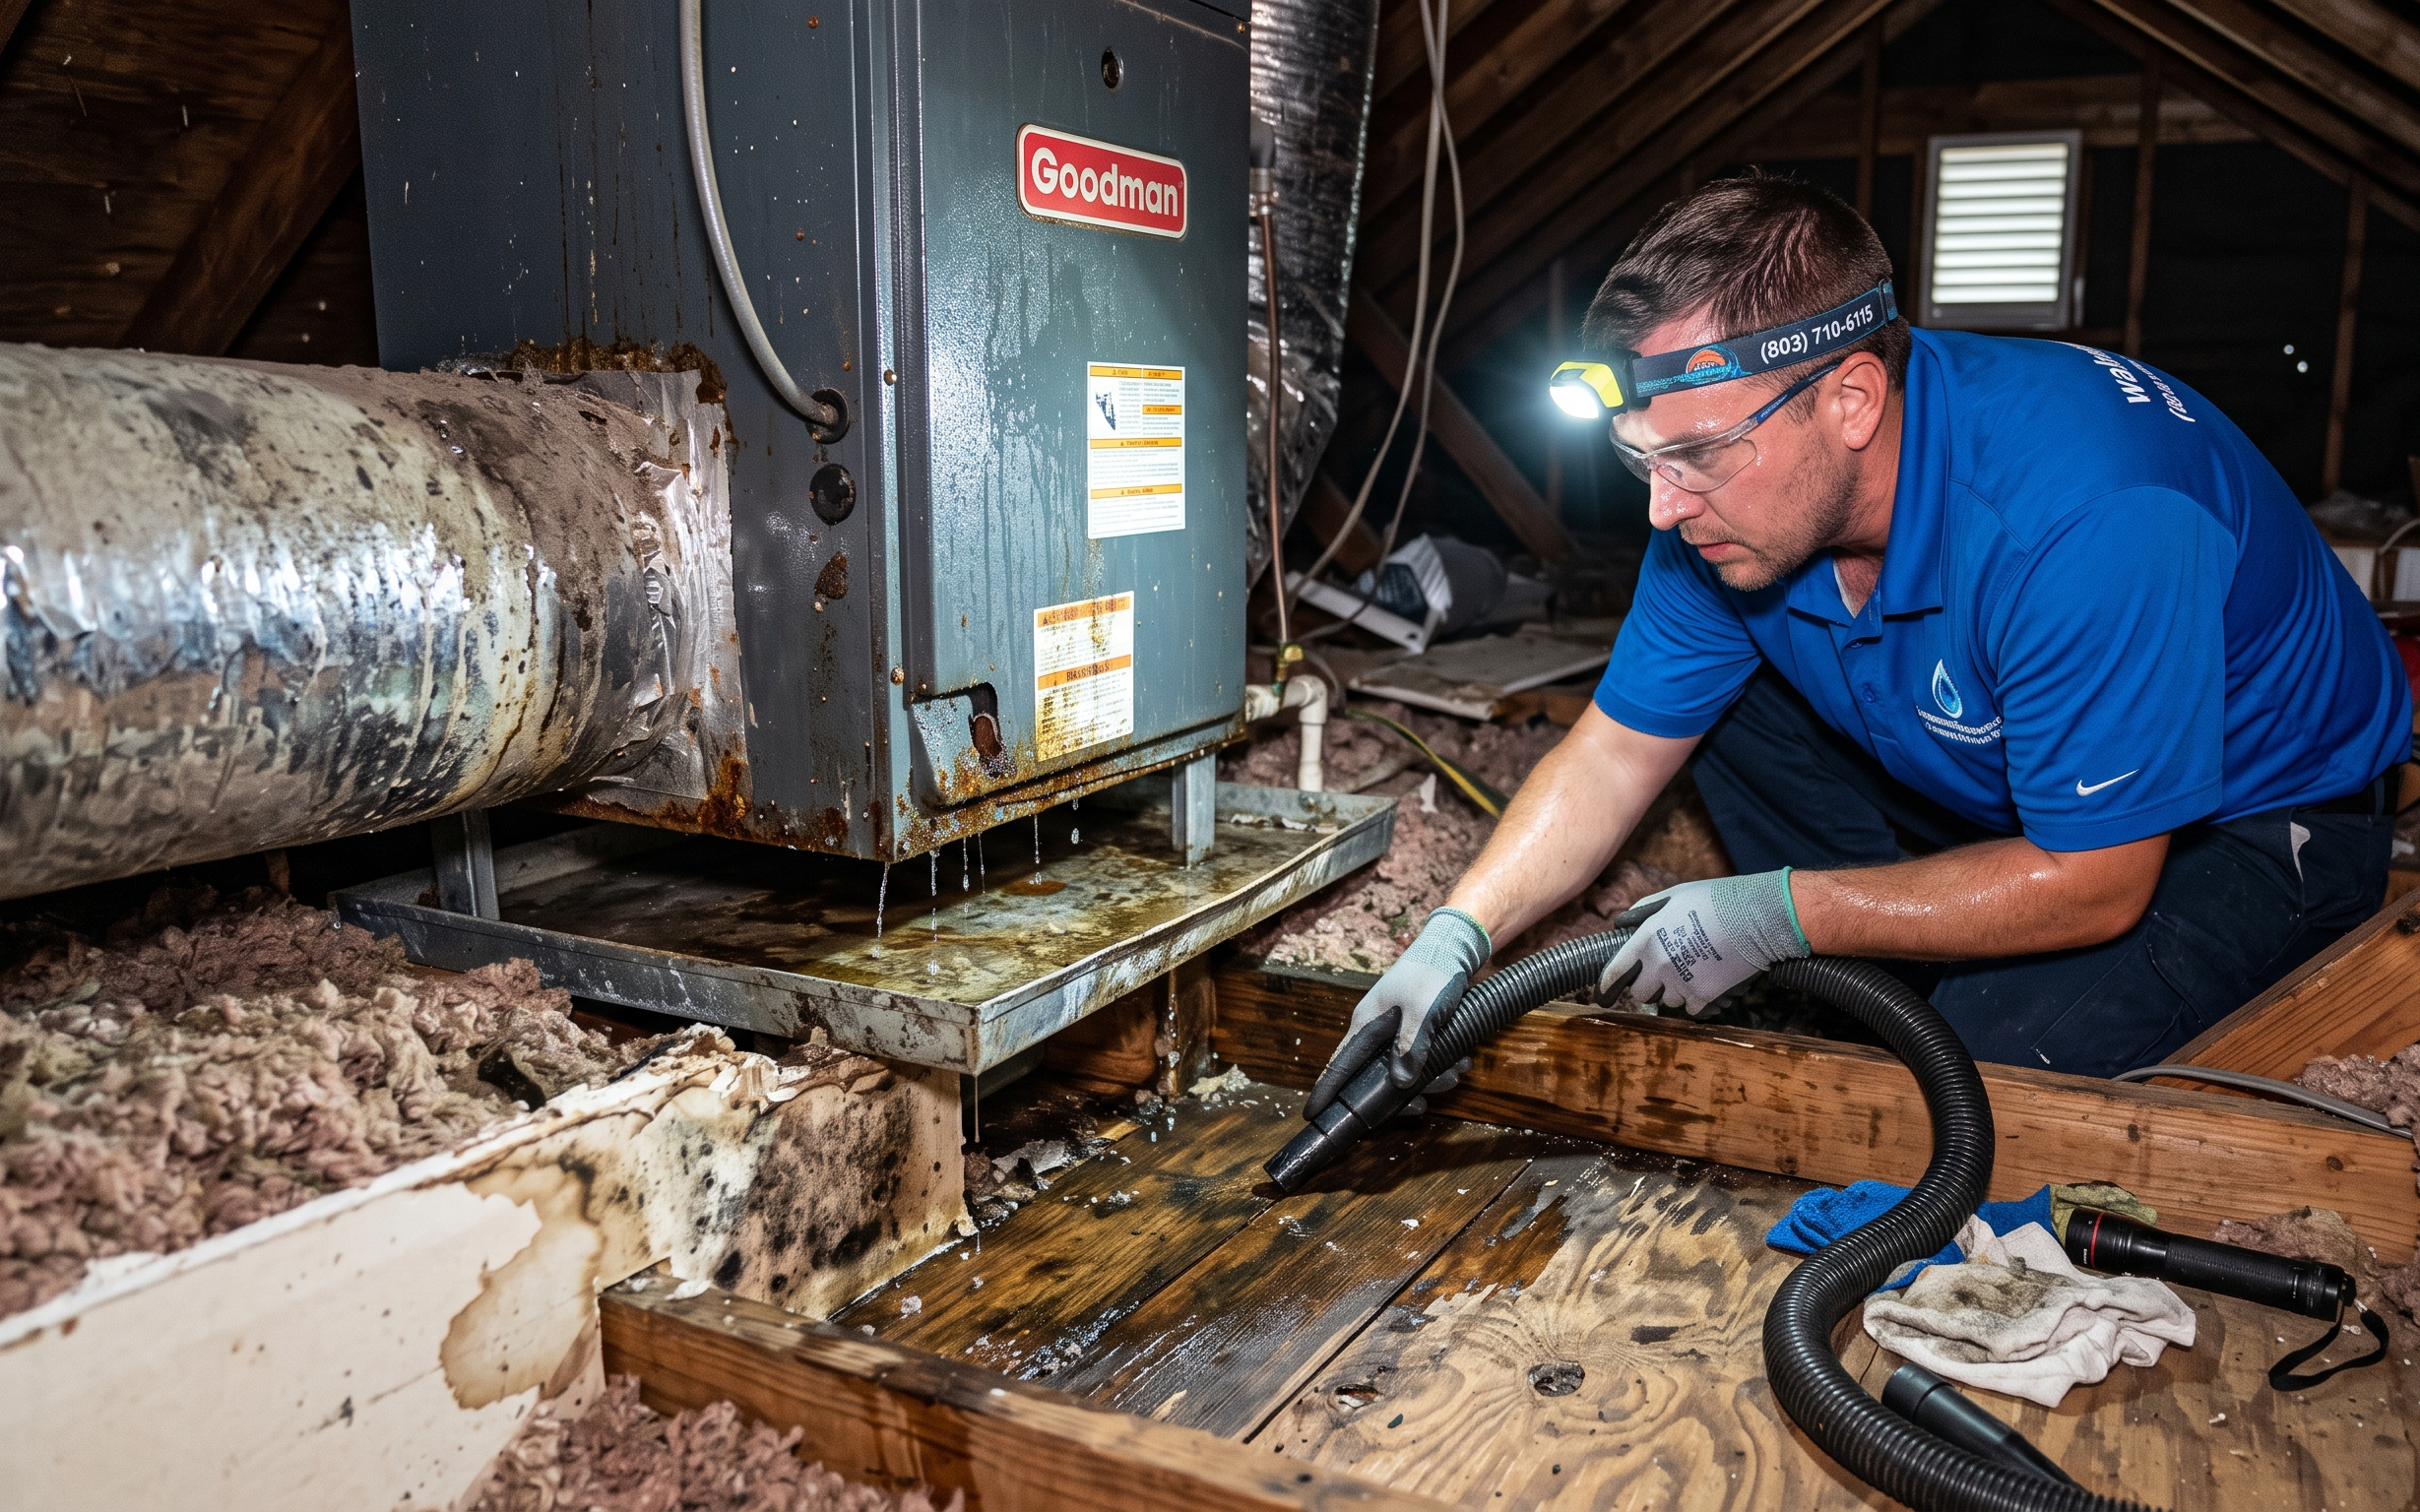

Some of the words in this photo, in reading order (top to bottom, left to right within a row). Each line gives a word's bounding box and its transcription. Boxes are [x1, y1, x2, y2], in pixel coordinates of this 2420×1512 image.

[1032, 147, 1178, 218] Goodman
[1760, 332, 1809, 364] (803)
[1812, 304, 1874, 346] 710-6115
